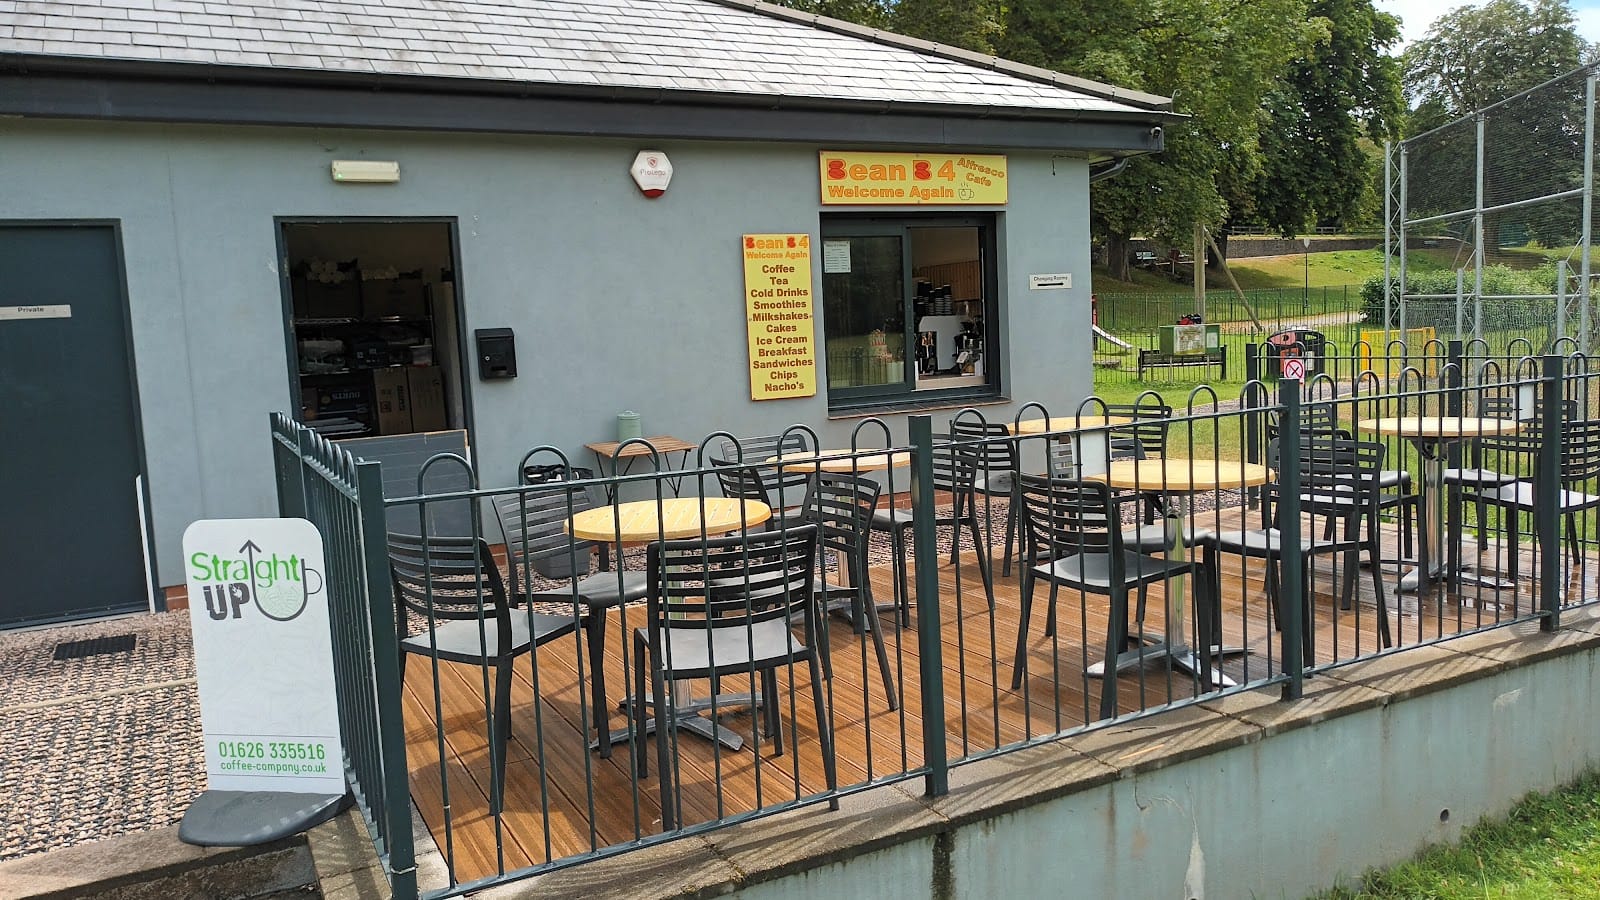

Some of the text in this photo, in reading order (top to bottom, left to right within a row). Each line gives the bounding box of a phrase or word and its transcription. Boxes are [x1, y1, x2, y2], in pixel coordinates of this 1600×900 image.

[826, 158, 956, 182] Bean B 4
[957, 157, 1005, 179] Alfresco
[965, 172, 992, 187] Cafe
[828, 185, 954, 200] Welcome Again
[745, 236, 784, 249] Bean
[798, 235, 809, 249] 4
[746, 251, 808, 260] Welcome Again
[762, 264, 795, 274] Coffee
[769, 276, 789, 286] Tea
[750, 287, 809, 298] Cold Drinks
[753, 300, 807, 310] Smoothies
[752, 312, 809, 322] Milkshakes
[766, 324, 797, 333] Cakes
[756, 335, 808, 346] Ice Cream
[758, 346, 807, 357] Breakfast
[752, 358, 813, 369] Sandwiches
[770, 371, 798, 381] Chips
[764, 381, 805, 392] Nacho's
[203, 582, 250, 620] UP
[218, 742, 325, 760] 01626 335516
[220, 760, 327, 775] coffee-company.co.uk
